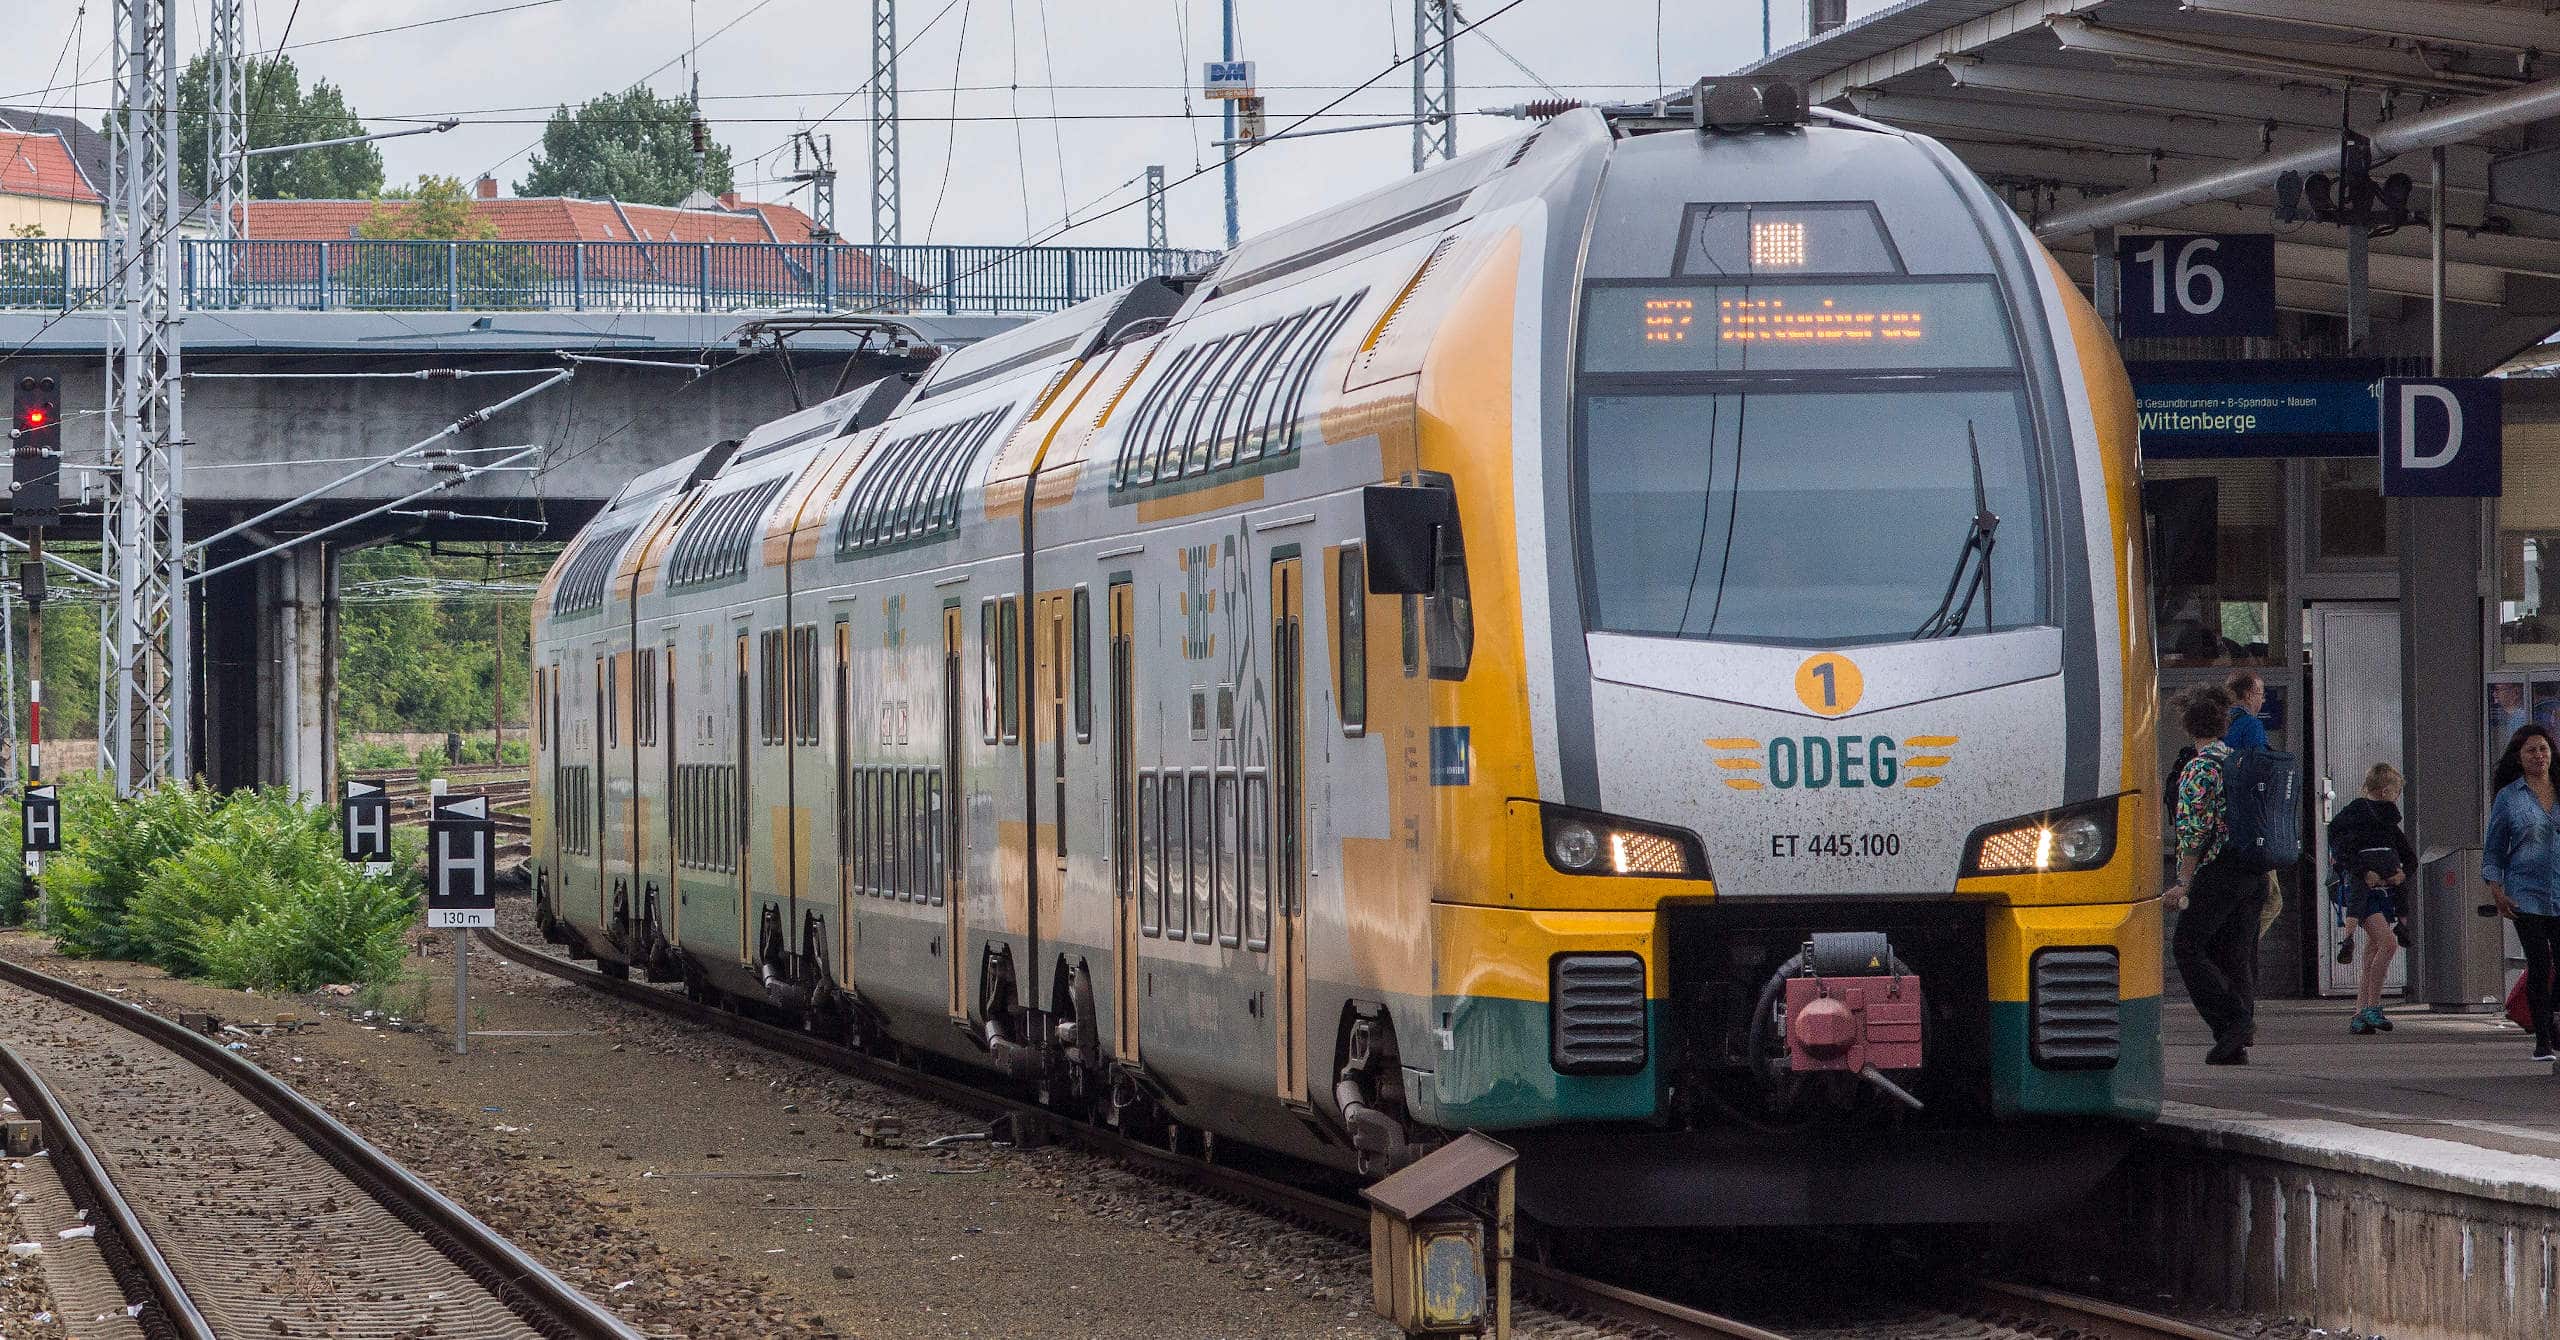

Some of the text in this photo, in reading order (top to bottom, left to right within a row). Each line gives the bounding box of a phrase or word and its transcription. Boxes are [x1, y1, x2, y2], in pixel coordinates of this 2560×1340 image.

[2135, 238, 2225, 315] 16
[2137, 411, 2257, 434] Wittenberge
[2145, 398, 2219, 409] Gesundbrunnen
[2227, 397, 2279, 410] B-Spandau
[2287, 396, 2317, 407] Nauen
[2401, 384, 2463, 469] D
[1812, 662, 1837, 707] 1
[1768, 735, 1898, 789] ODEG
[27, 804, 56, 845] H
[350, 805, 384, 854] H
[1771, 833, 1900, 858] ET 445.100
[438, 830, 485, 896] H
[442, 911, 481, 925] 130 m
